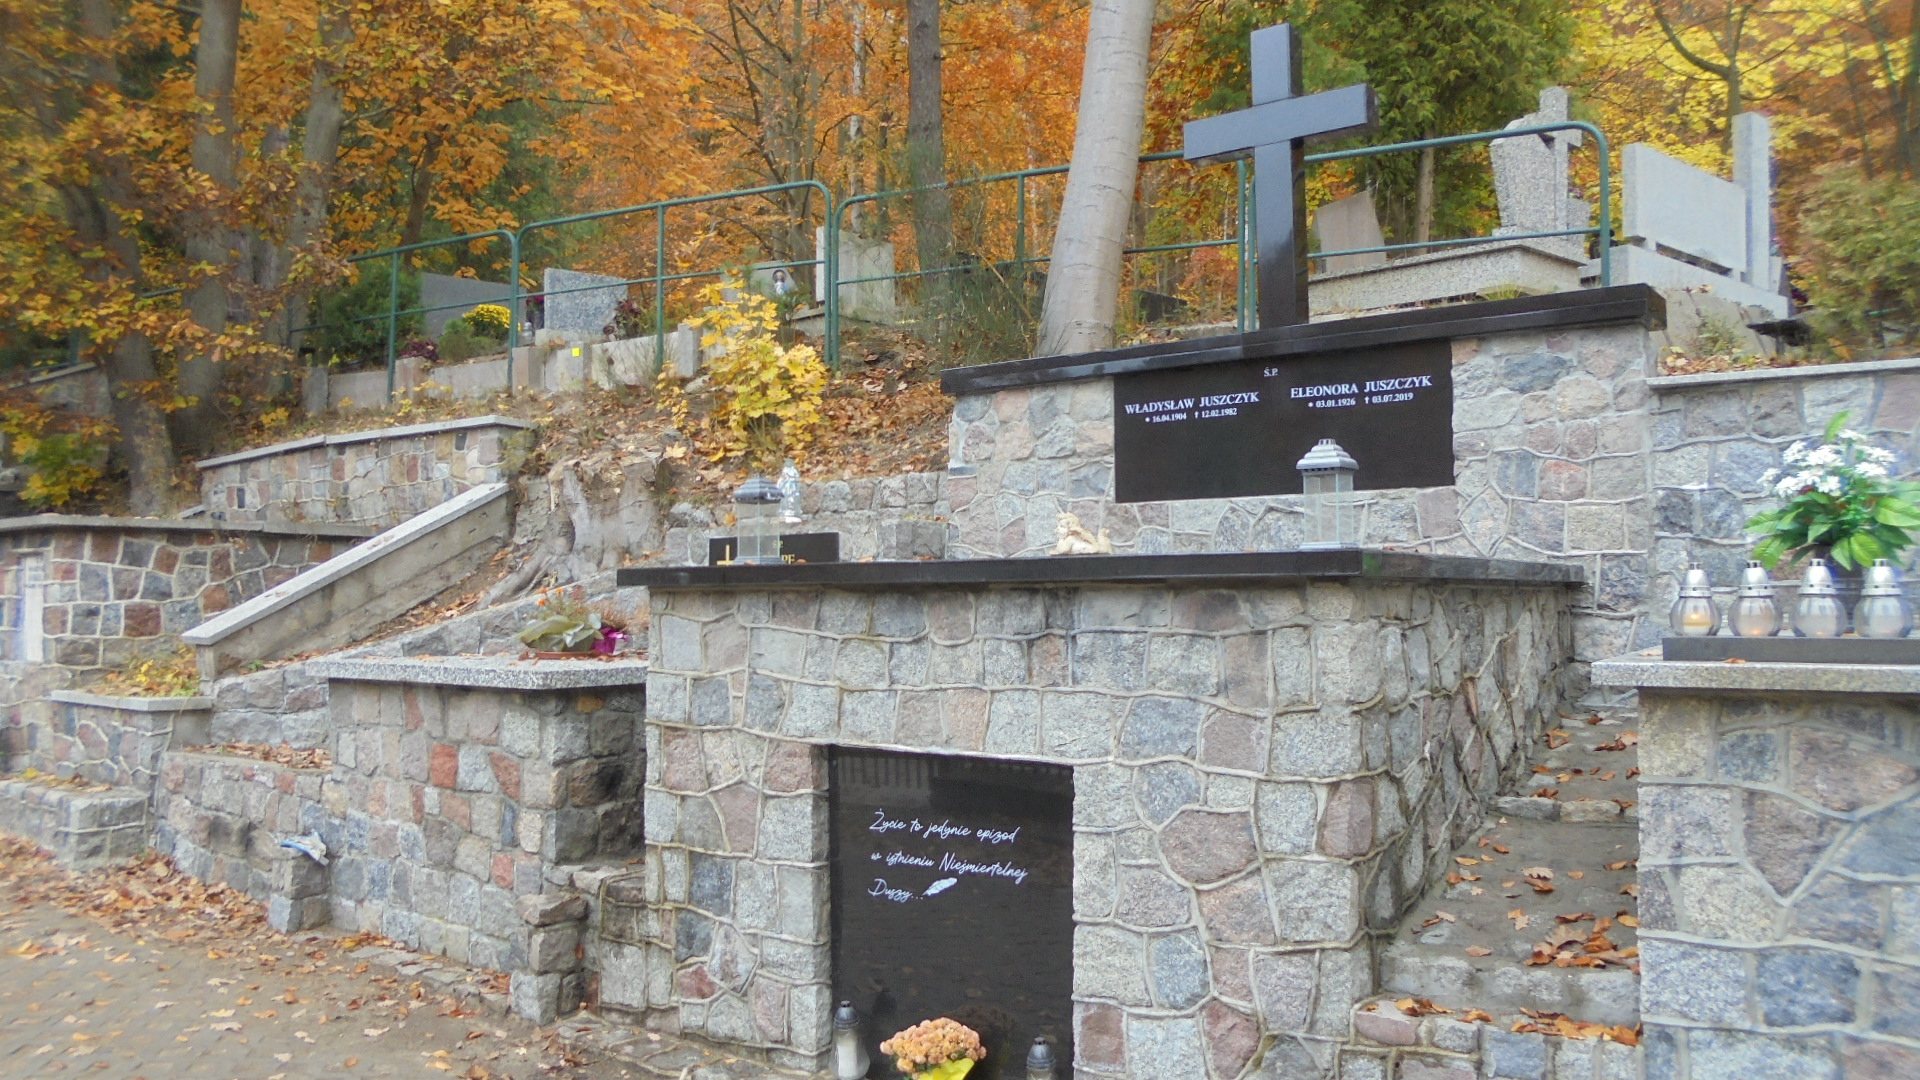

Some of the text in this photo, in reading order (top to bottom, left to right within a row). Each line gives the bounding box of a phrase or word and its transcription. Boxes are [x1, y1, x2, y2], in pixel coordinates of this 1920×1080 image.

[1290, 375, 1433, 399] ELEONORA JUSZCZYK
[1124, 391, 1260, 415] WŁADYSŁAW JUSZCZYK
[1315, 398, 1356, 408] 03.01.1926
[869, 807, 1021, 844] Życie to jedynie epizod
[871, 850, 1029, 885] w istnieniu Nieśmiertelnej
